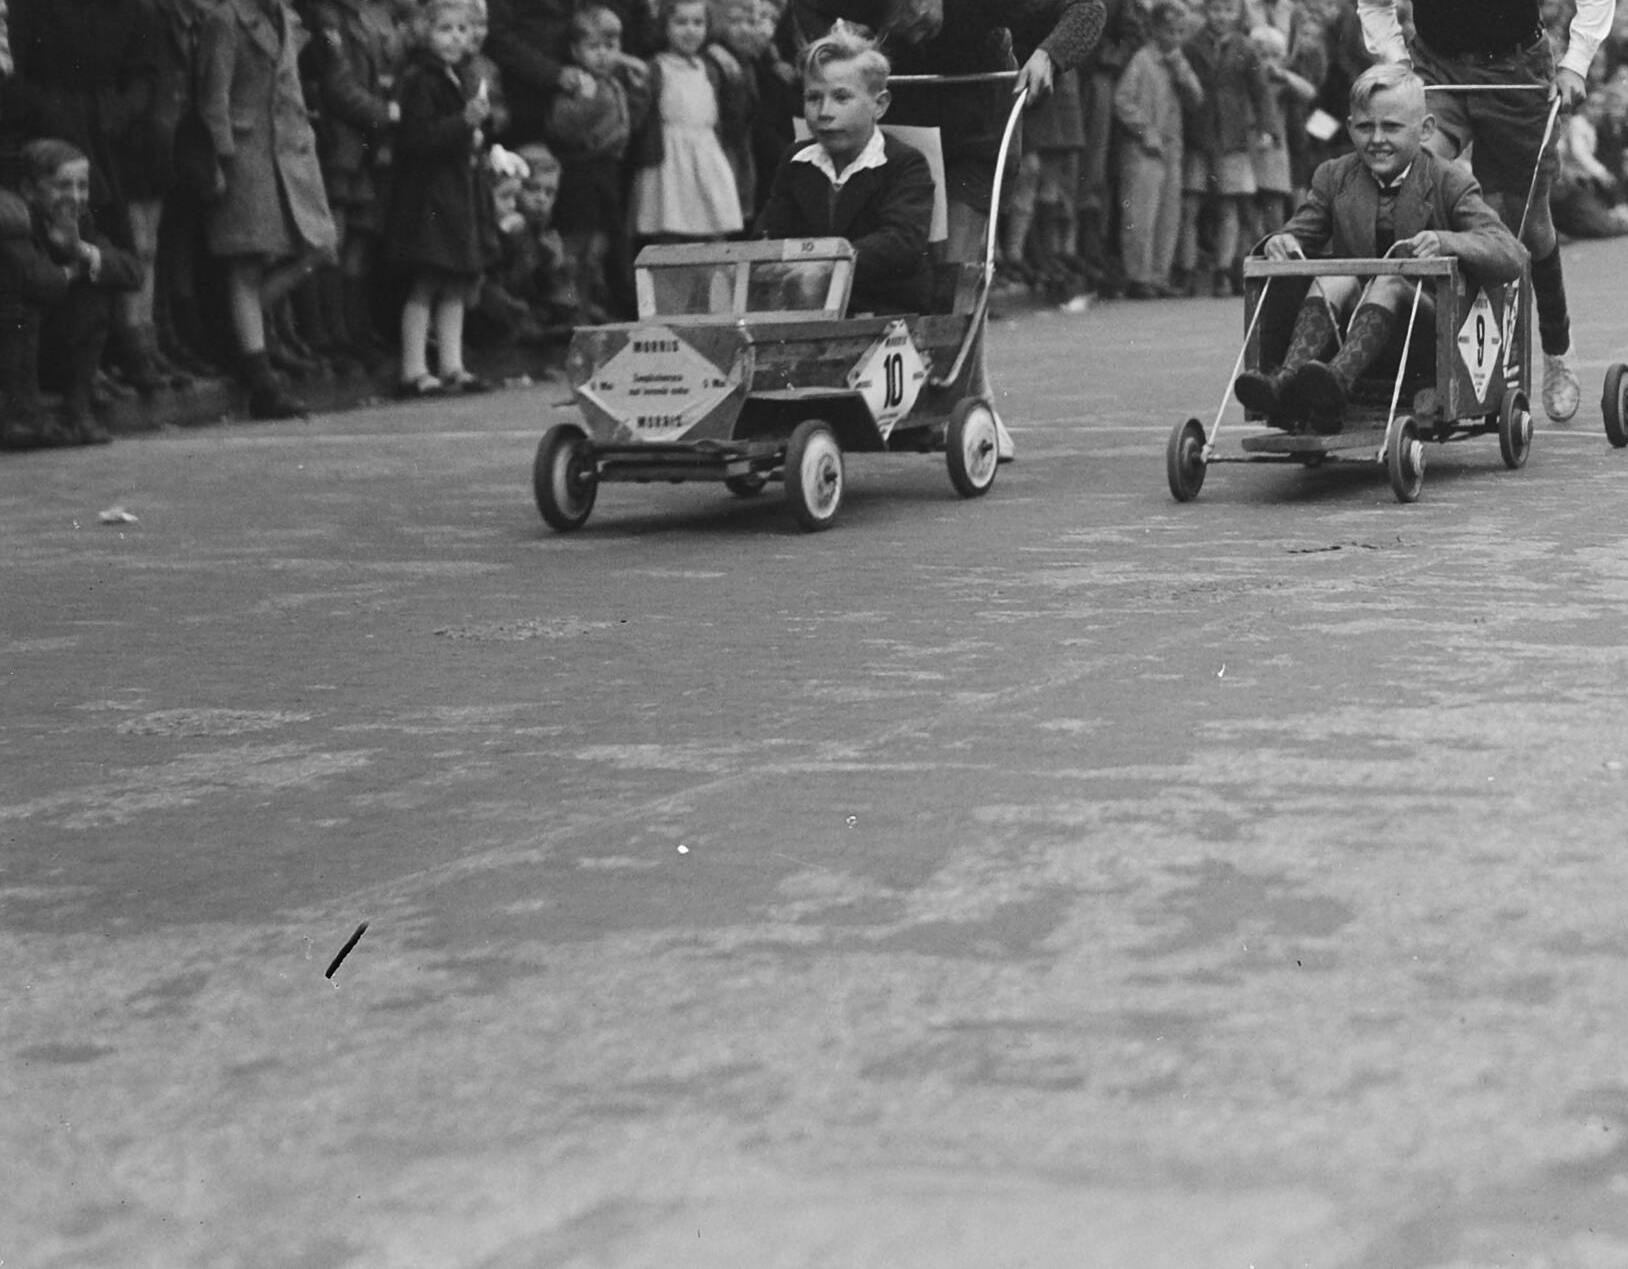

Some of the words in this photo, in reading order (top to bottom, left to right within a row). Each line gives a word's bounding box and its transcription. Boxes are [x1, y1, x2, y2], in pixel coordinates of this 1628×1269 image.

[632, 340, 680, 353] MORRIS
[1476, 314, 1485, 368] 9
[883, 352, 904, 410] 10
[637, 414, 683, 428] MORRIS
